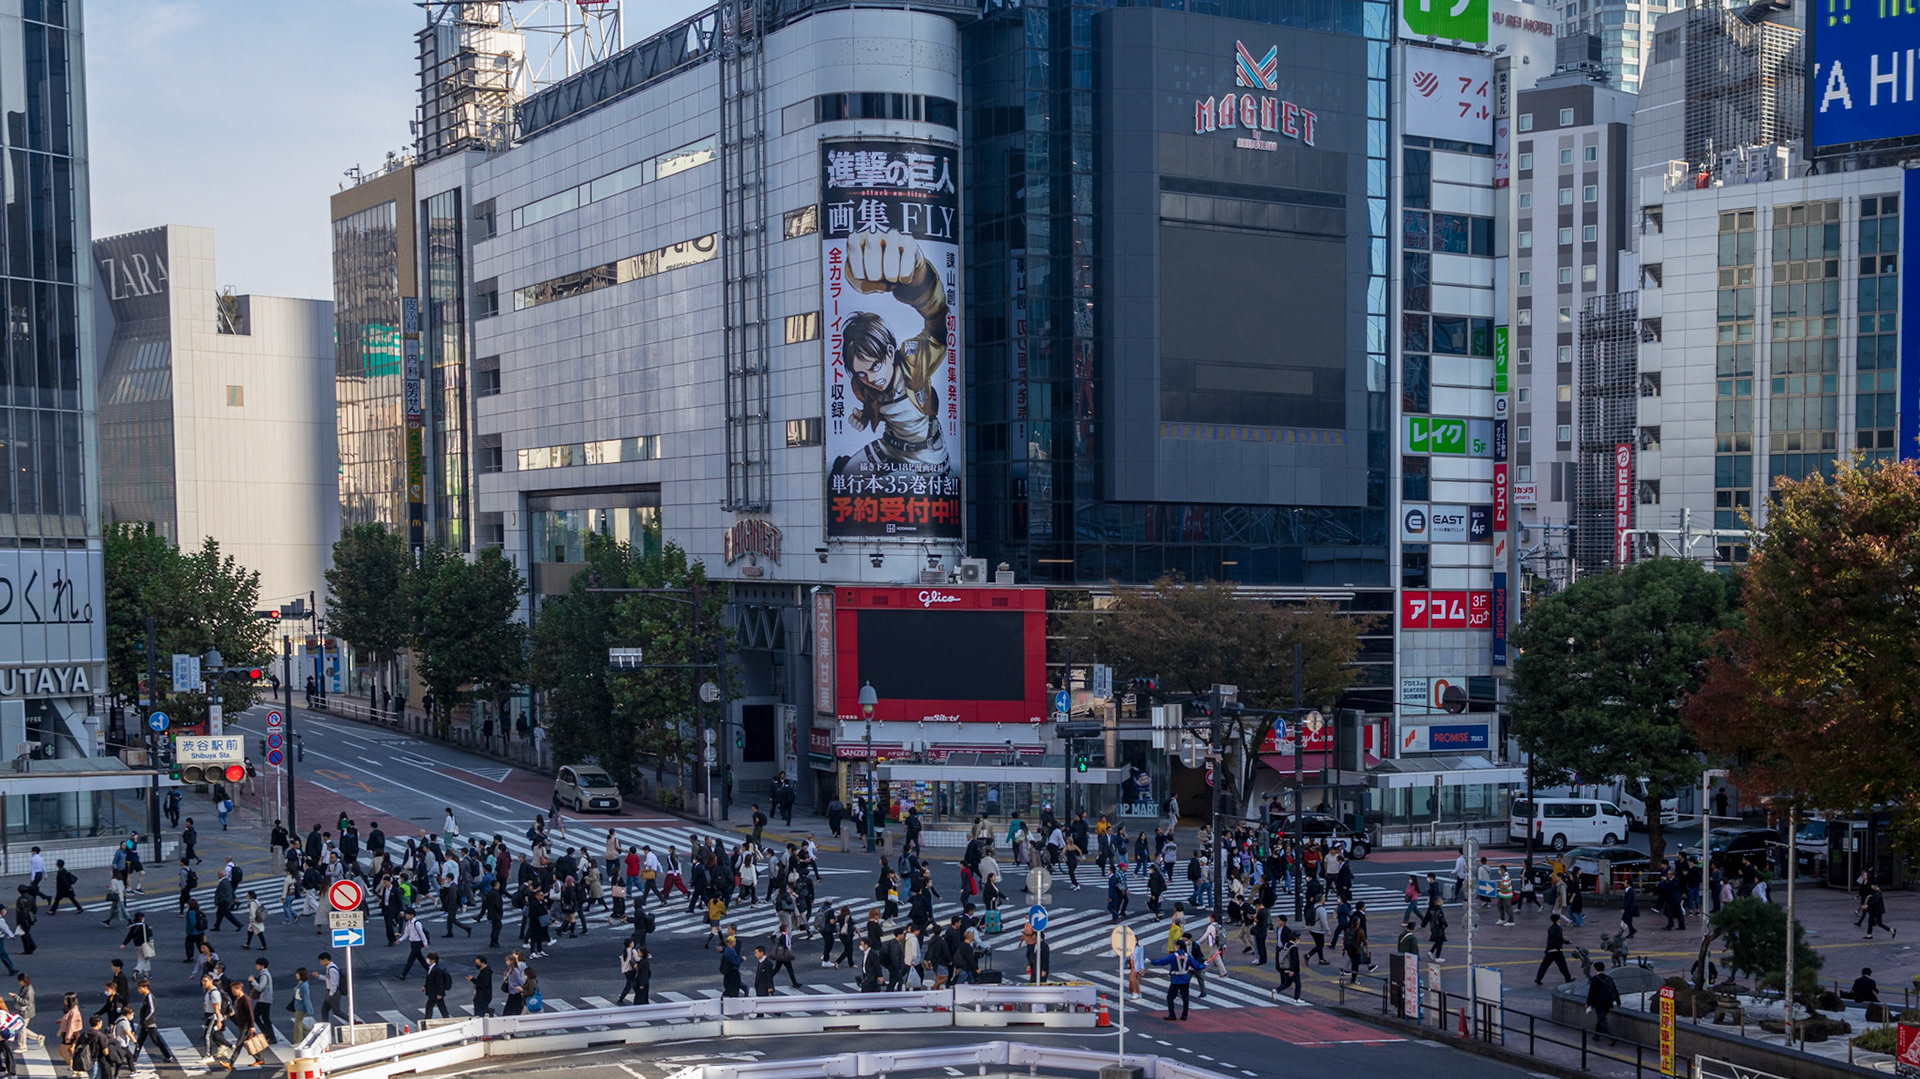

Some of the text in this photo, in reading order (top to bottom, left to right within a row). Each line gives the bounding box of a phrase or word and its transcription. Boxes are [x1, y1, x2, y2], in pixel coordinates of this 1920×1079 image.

[1523, 18, 1555, 36] HOTEL
[1459, 76, 1489, 98] アイ
[1814, 48, 1920, 113] A HI
[1195, 93, 1318, 147] MAGNET
[1459, 101, 1490, 120] フル
[827, 148, 955, 194] 進撃の巨人
[827, 198, 955, 239] 画集 FLY
[1456, 240, 1467, 251] 7F
[101, 253, 168, 300] ZARA
[405, 300, 417, 332] 皮ふ科
[828, 247, 845, 435] 全カラーイラスト収録!!
[1497, 333, 1505, 367] レイク
[407, 354, 418, 377] 内科
[946, 315, 957, 436] 初の画集発売!!
[407, 381, 419, 414] 処方せん
[1413, 422, 1462, 444] レイク
[1473, 439, 1487, 453] 5F
[831, 474, 959, 496] 単行本35巻付き!!
[831, 496, 959, 524] 予約受付中!!
[1496, 487, 1505, 521] アコム
[1433, 515, 1465, 525] EAST
[1471, 519, 1485, 534] 4F
[724, 518, 783, 566] MAGNET
[918, 590, 961, 608] Glico
[1410, 599, 1465, 621] アコム
[1472, 595, 1487, 607] 3F
[1470, 614, 1484, 624] 入口
[1496, 588, 1505, 639] PROMISE
[0, 666, 90, 695] UTAYA
[180, 657, 188, 689] 渋谷駅前
[182, 739, 239, 752] 渋谷駅前
[1434, 732, 1468, 743] PROMISE
[191, 752, 217, 760] Shibuya
[1131, 803, 1159, 816] MART
[1660, 988, 1674, 999] バス停
[1661, 1000, 1671, 1071] 駐停車禁止
